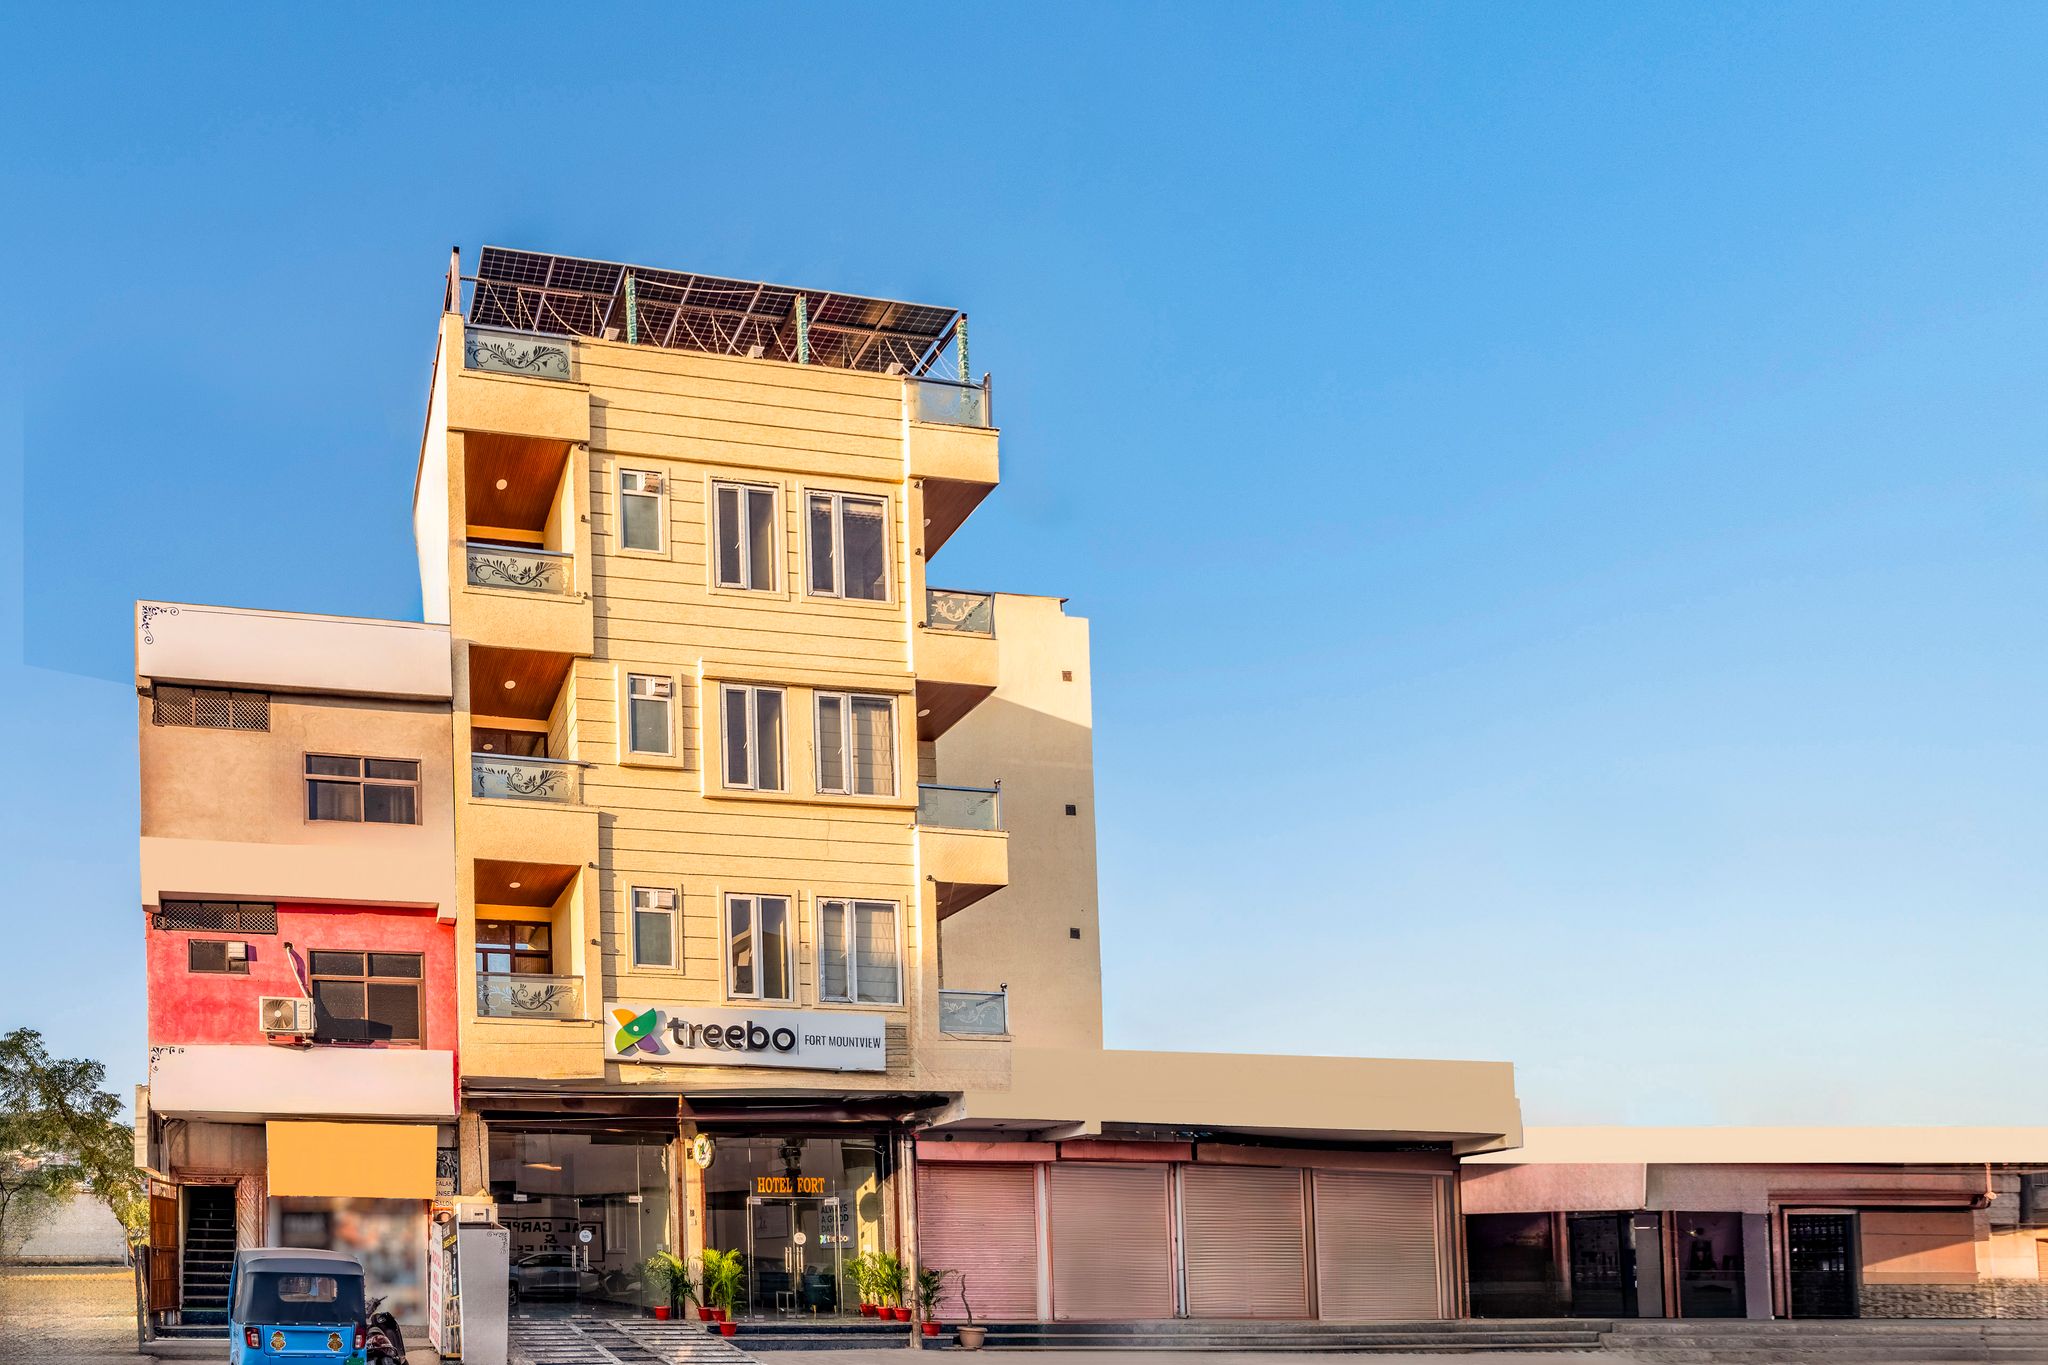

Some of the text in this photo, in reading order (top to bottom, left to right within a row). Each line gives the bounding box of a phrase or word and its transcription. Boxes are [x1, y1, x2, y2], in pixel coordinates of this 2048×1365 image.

[666, 1017, 796, 1051] treebo
[804, 1034, 882, 1049] FORT MOUNTVIEW
[757, 1176, 826, 1193] HOTEL FORT
[821, 1204, 848, 1214] ALWYS
